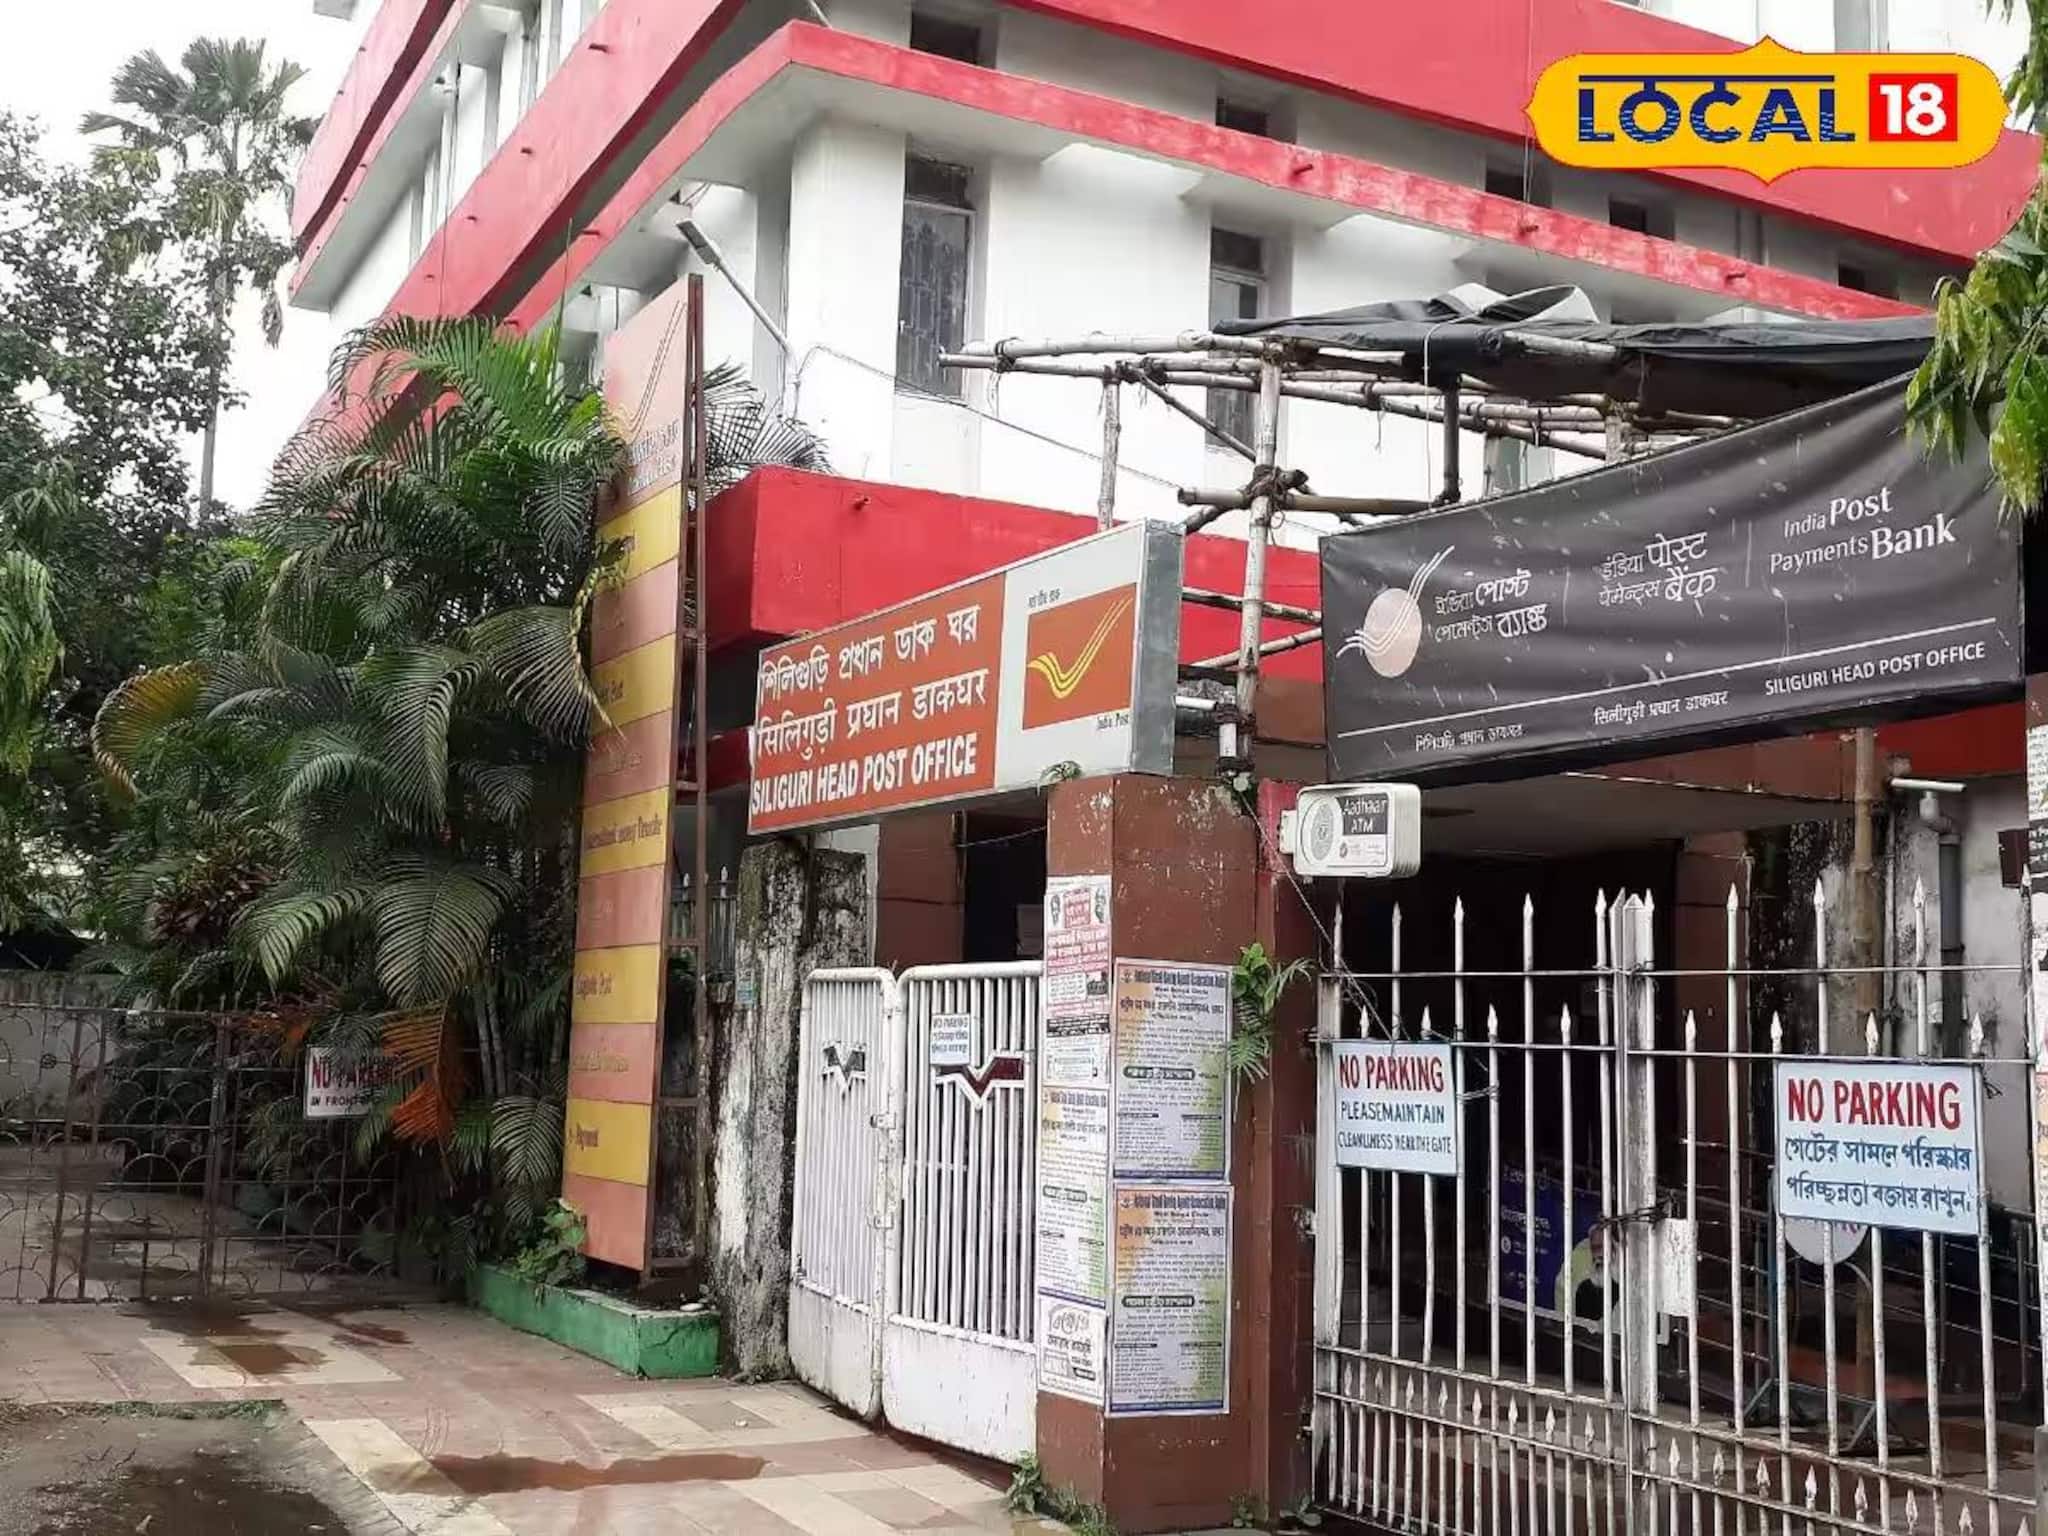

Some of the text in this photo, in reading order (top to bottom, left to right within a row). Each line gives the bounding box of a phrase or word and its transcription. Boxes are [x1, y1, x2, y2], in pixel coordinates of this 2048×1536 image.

[1784, 486, 1894, 538] India Post
[1602, 532, 1708, 581] इंडिया पोस्ट
[1769, 513, 1956, 575] Payments Bank
[1475, 568, 1532, 606] পোস্ট
[1663, 566, 1719, 601] बैंक
[760, 605, 981, 704] শিলিগুড়ি প্রধান ডাক ঘর
[1765, 641, 1986, 696] SILIGURI HEAD POST OFFICE
[758, 698, 838, 760] सिलिगुड़ी
[912, 668, 989, 720] डाकघर
[752, 733, 977, 814] SILIGURI HEAD POST OFFICE
[1343, 797, 1387, 816] Aadhaar
[1350, 818, 1375, 833] ATM
[1339, 1054, 1445, 1093] NO PARKING
[1788, 1078, 1961, 1130] NO PARKING
[1785, 1131, 1840, 1162] গেটের
[1842, 1138, 1898, 1168] সামনে
[1786, 1170, 1869, 1207] পরিচ্ছন্নতা
[1872, 1182, 1919, 1211] বজায়
